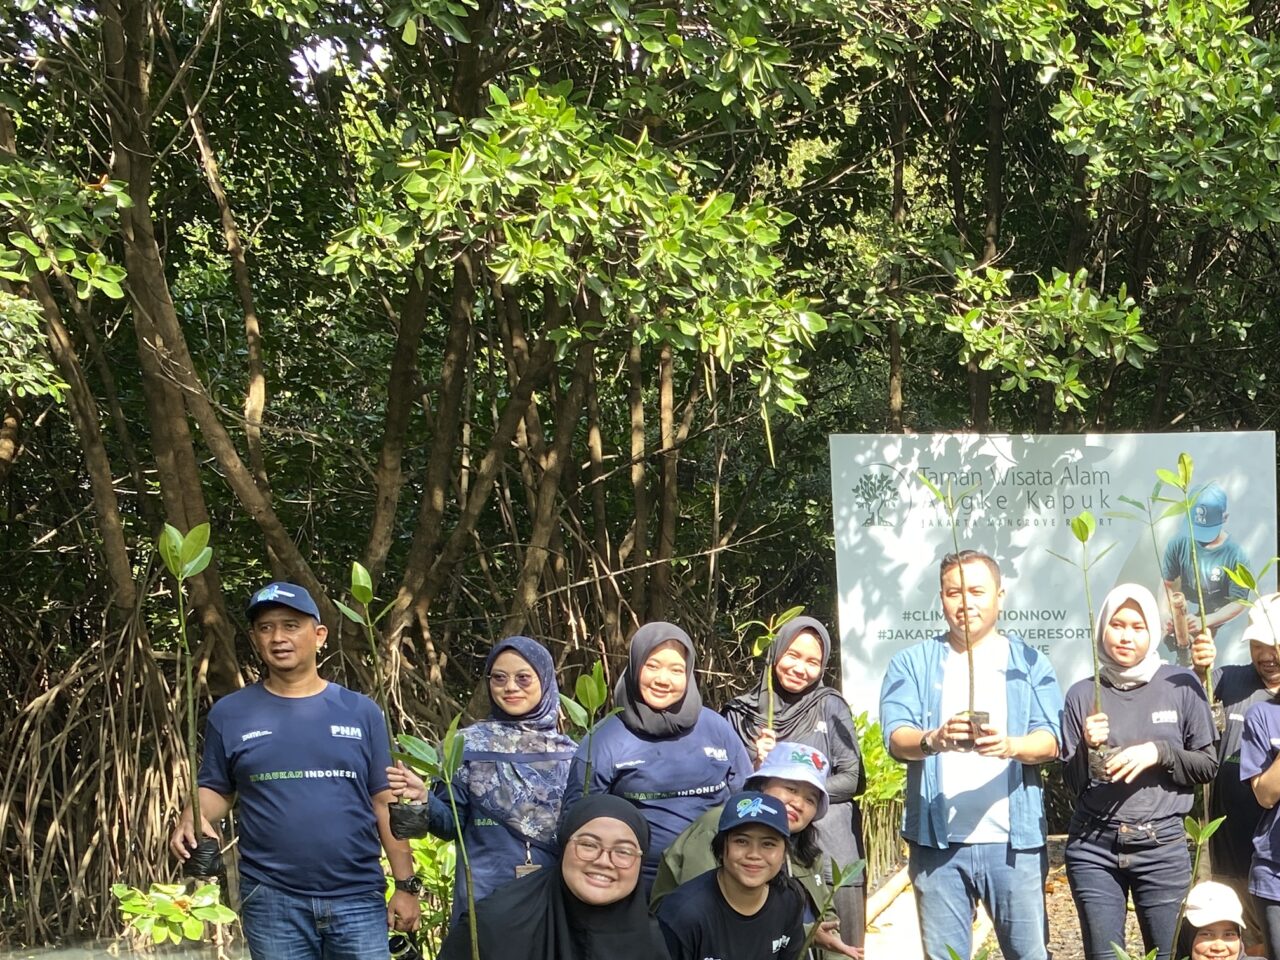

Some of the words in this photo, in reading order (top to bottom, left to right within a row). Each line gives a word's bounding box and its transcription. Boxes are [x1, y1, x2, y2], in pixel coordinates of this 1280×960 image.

[918, 466, 982, 486] Taman
[990, 466, 1054, 486] Wisata
[1060, 465, 1110, 486] Alam
[1027, 488, 1111, 516] Kapuk
[921, 519, 978, 528] JAKARTA
[987, 518, 1056, 528] MANGROVE
[1065, 518, 1112, 527] RRT
[902, 610, 1066, 622] #CLIMTIONNOW
[330, 725, 362, 740] PNM
